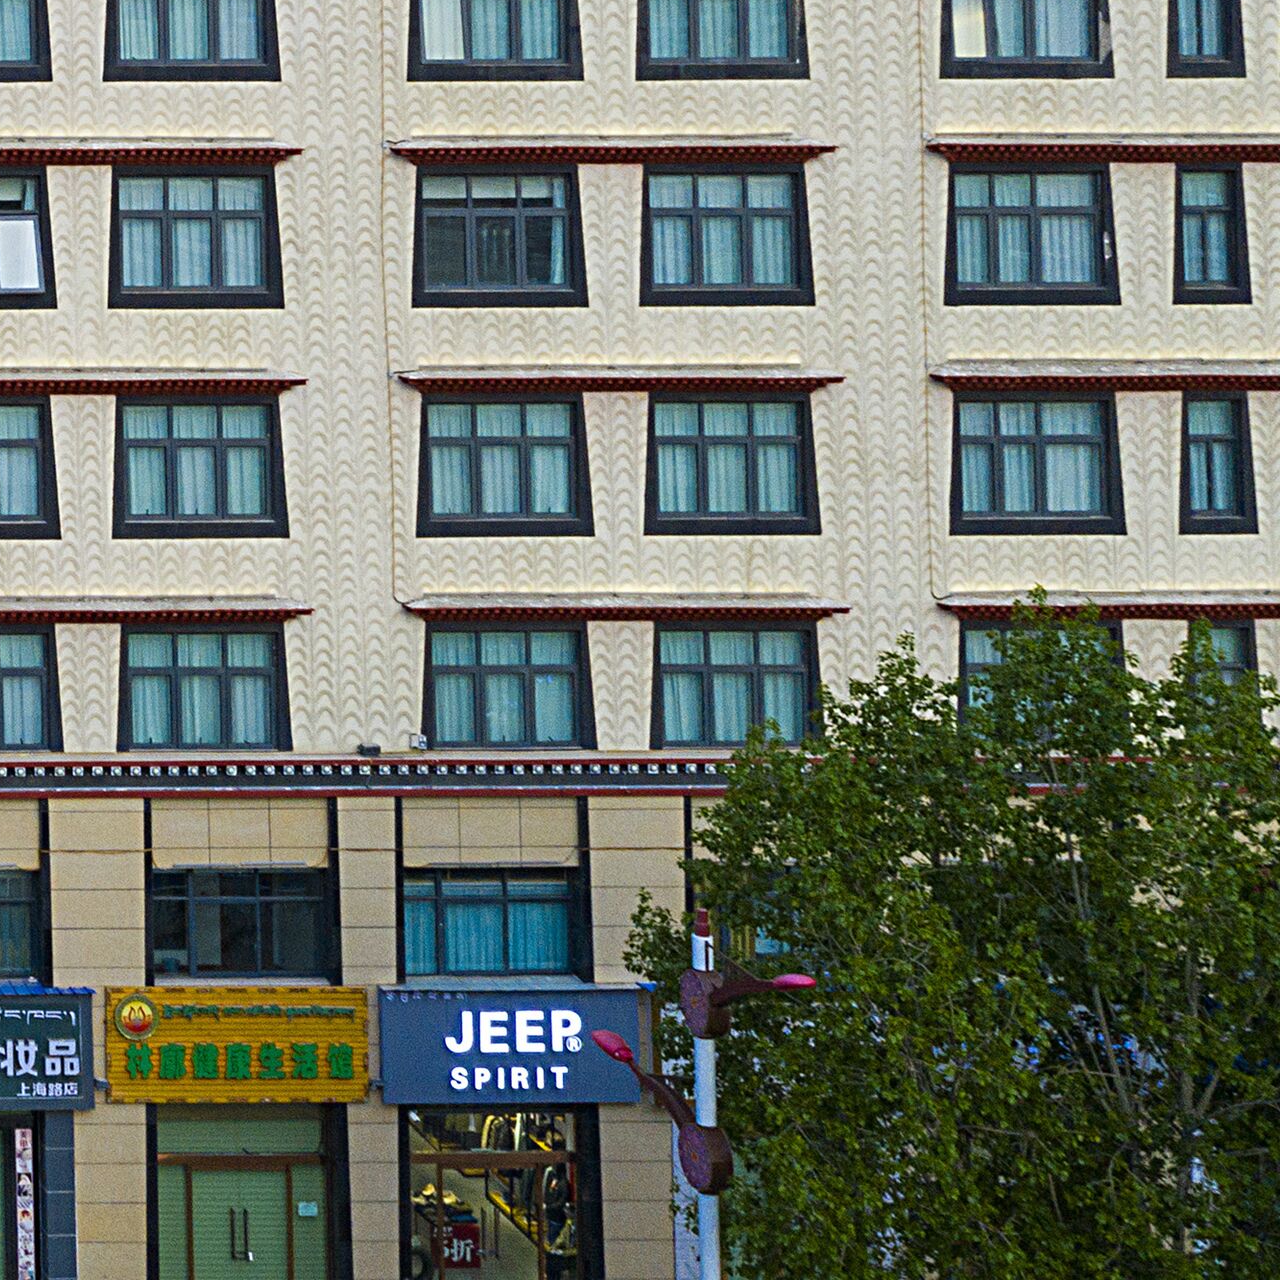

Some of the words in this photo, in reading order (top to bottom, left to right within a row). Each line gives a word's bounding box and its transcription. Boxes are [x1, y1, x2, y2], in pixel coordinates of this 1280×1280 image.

[444, 1009, 582, 1053] JEEP
[16, 1081, 79, 1097] 上海路店
[450, 1066, 568, 1090] SPIRIT
